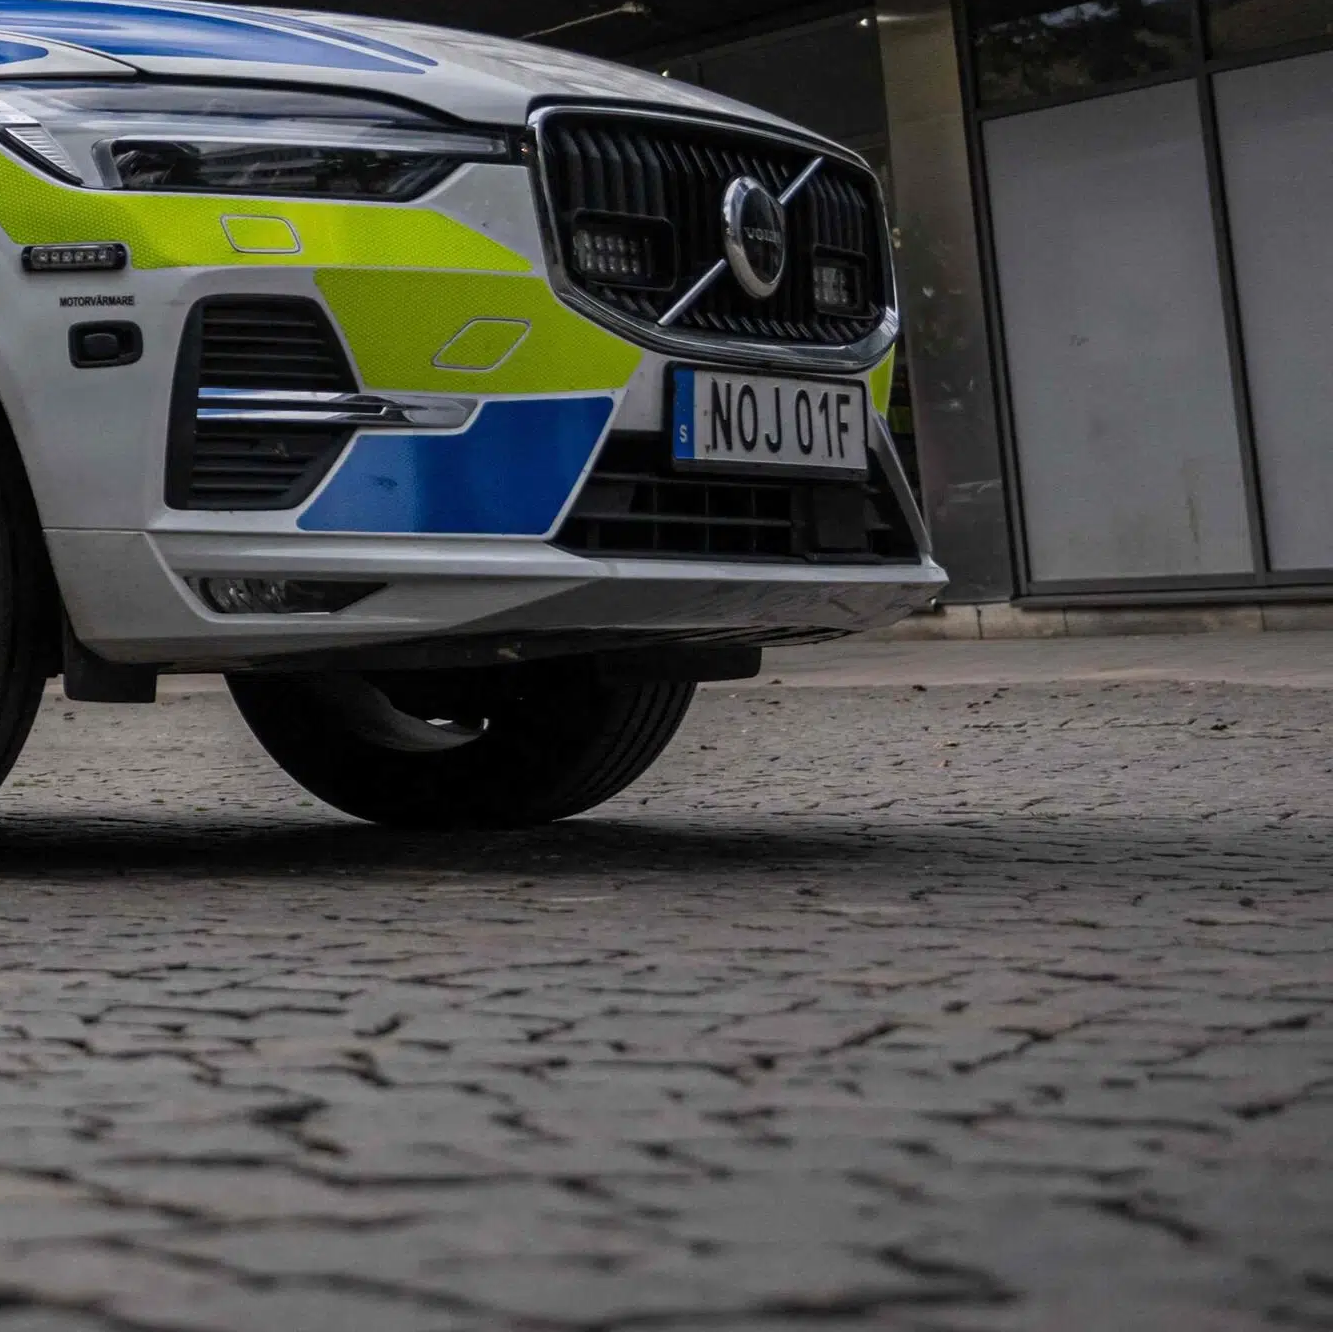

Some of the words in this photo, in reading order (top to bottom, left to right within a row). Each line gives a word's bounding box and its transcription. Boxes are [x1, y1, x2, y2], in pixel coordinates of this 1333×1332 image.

[59, 295, 135, 307] MOTORVÄRMARE
[711, 377, 782, 454] NOJ
[795, 388, 851, 459] 01F
[679, 424, 689, 444] S
